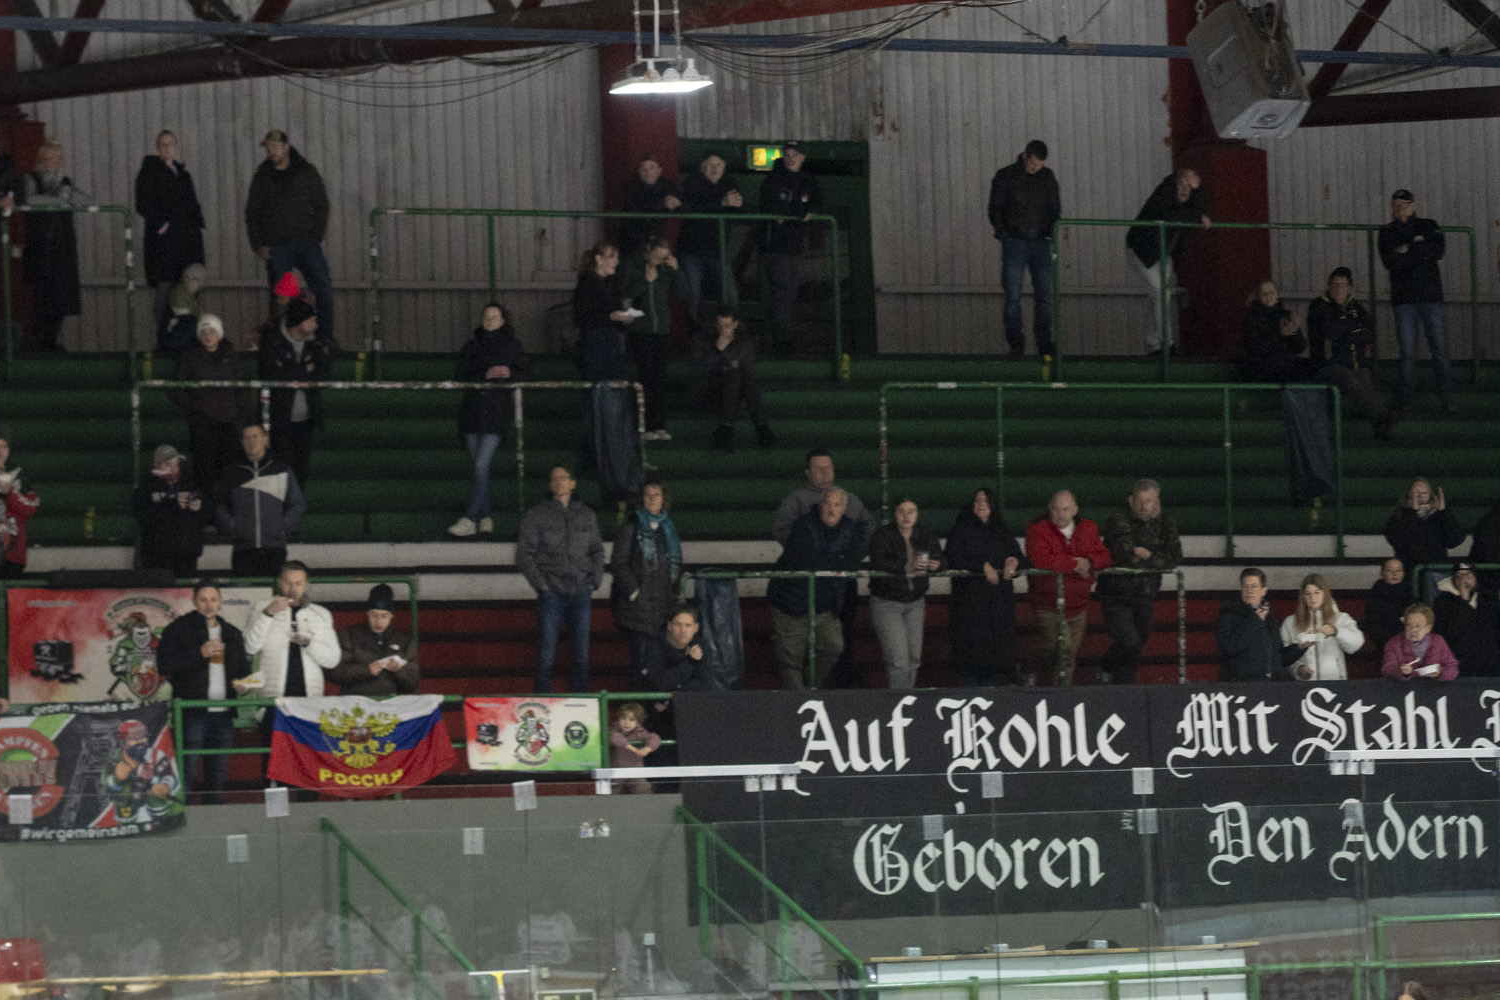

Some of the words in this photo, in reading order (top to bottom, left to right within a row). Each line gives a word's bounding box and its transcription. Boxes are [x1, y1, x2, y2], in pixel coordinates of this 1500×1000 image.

[318, 768, 404, 788] РОССИЯ
[795, 696, 917, 790] Auf
[936, 696, 1130, 792] Kohle
[1166, 690, 1280, 778] Mit
[1292, 687, 1461, 766] Stahl
[853, 822, 1105, 896] Geboren
[1203, 801, 1316, 886] Den
[1329, 793, 1488, 882] Adern
